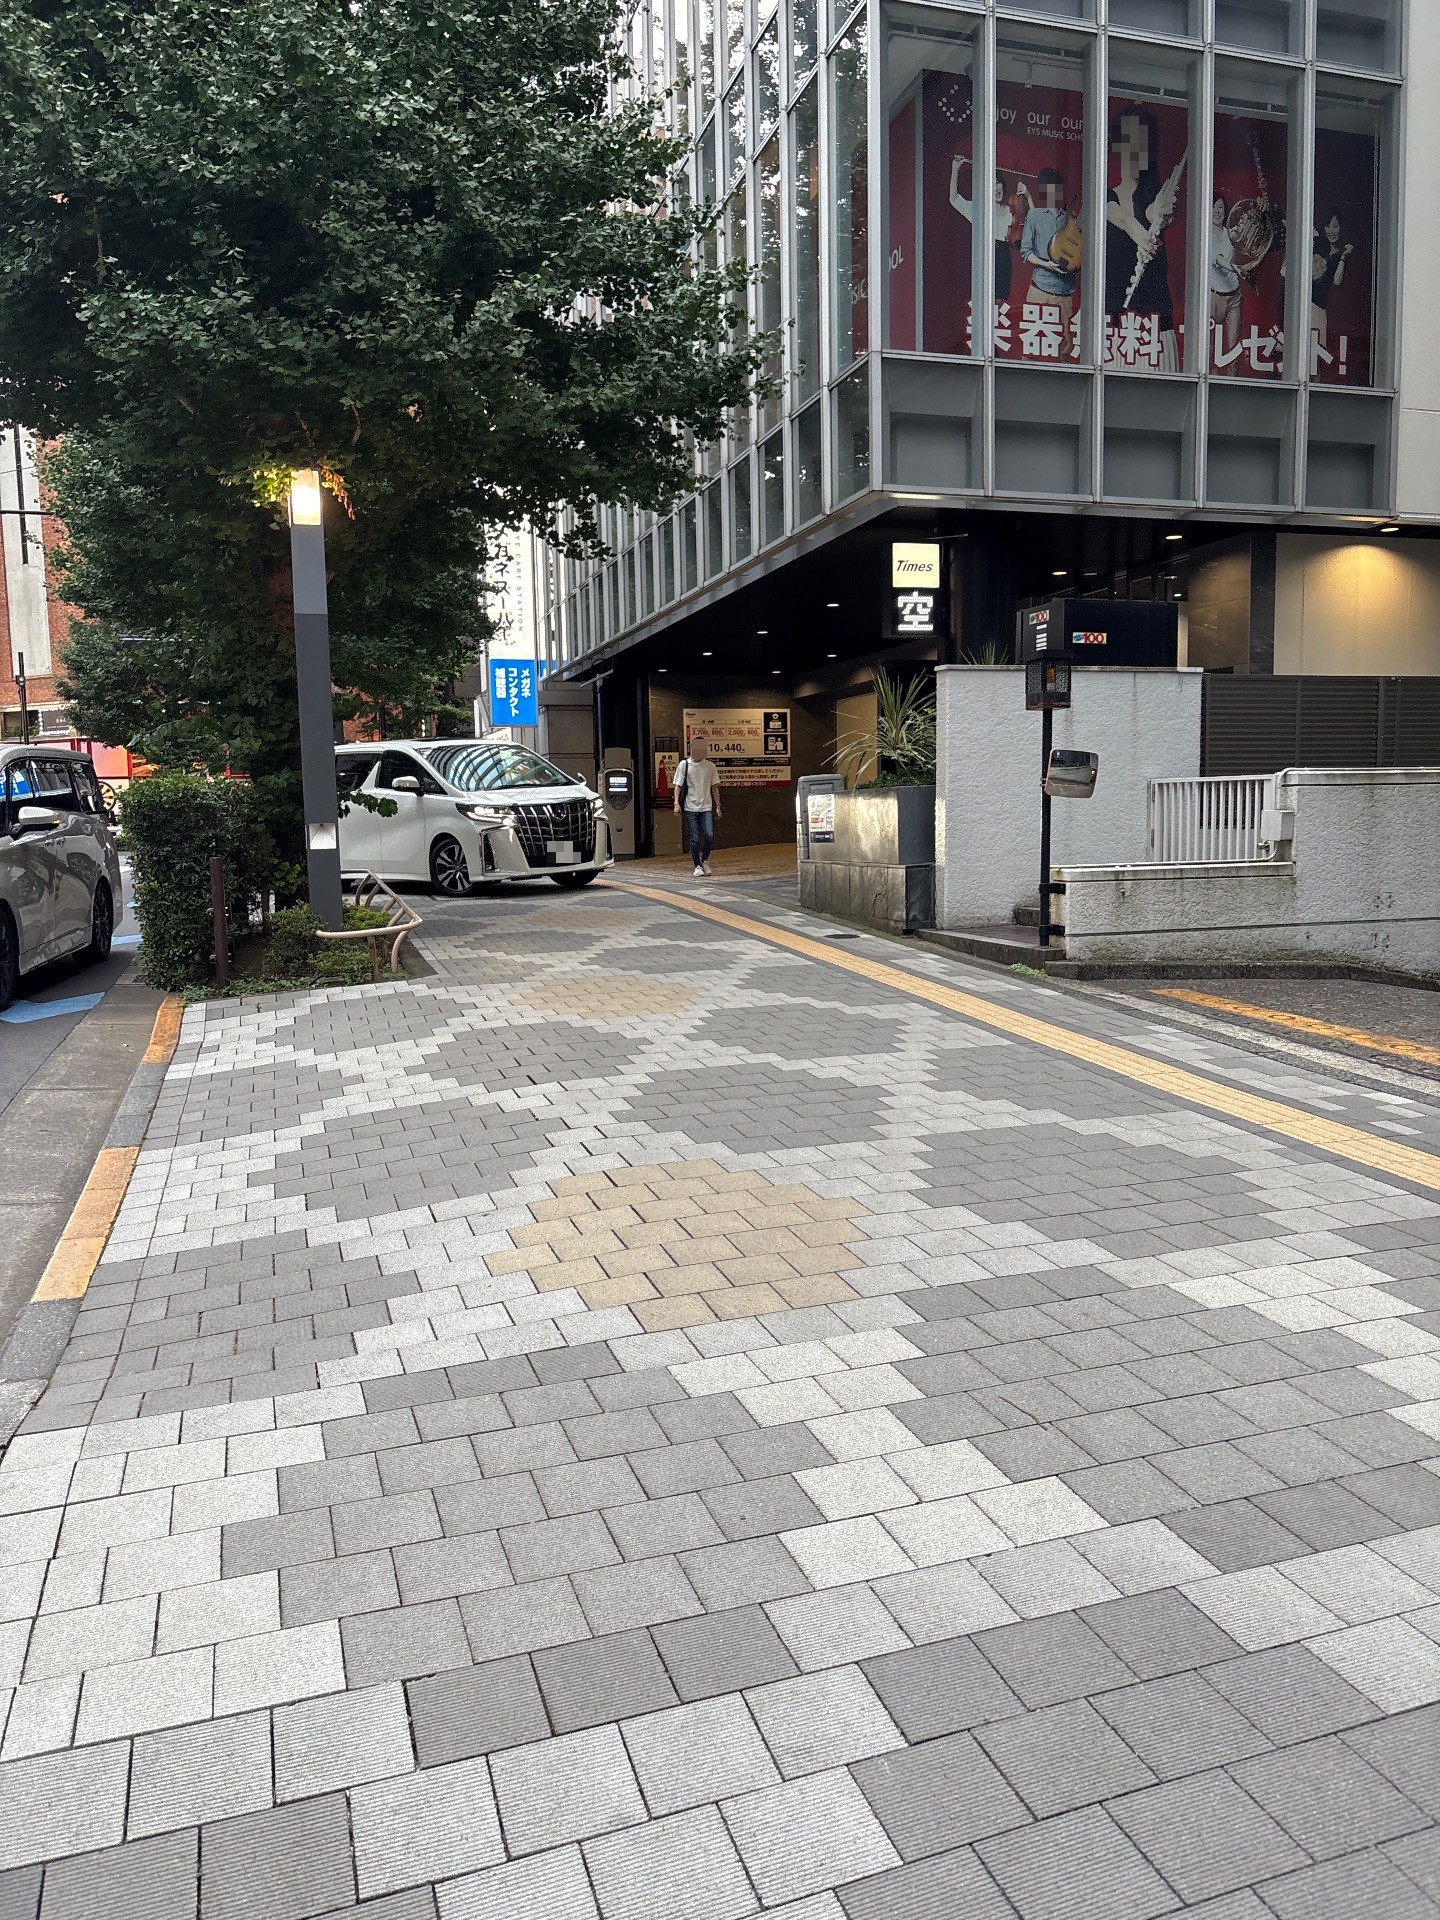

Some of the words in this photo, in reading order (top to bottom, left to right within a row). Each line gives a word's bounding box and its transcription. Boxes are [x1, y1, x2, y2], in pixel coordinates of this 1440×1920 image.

[1027, 111, 1051, 126] our
[1042, 129, 1065, 140] MUSIC
[896, 560, 933, 572] Times
[516, 586, 524, 632] STATION
[897, 590, 934, 631] 空
[1082, 632, 1105, 643] 100
[508, 667, 520, 718] コンタクト
[521, 668, 532, 699] メガネ
